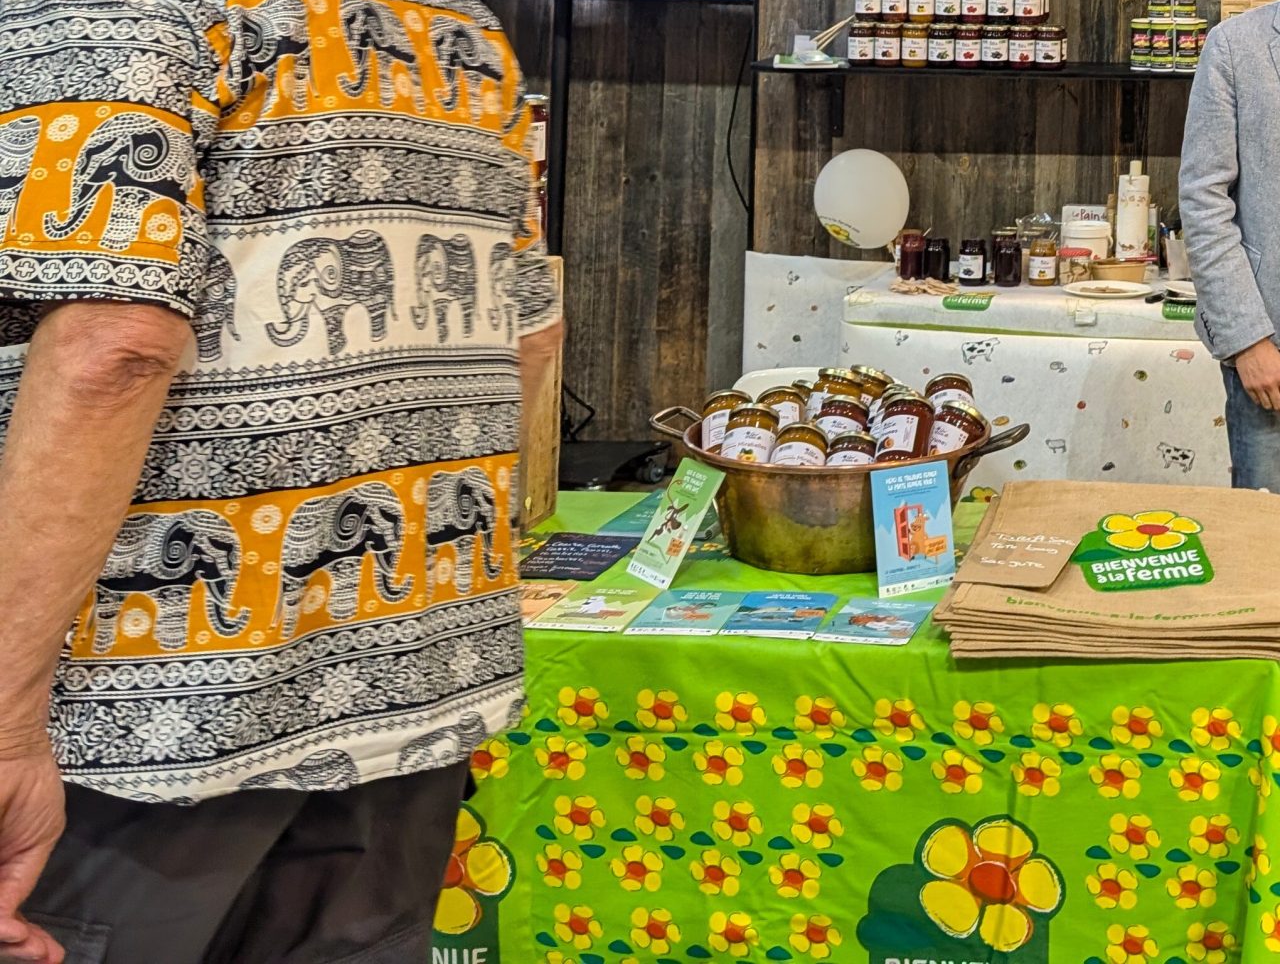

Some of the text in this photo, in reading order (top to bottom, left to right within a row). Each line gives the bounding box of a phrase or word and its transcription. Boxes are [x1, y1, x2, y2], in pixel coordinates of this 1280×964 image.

[1080, 208, 1100, 221] Pain
[1091, 549, 1200, 575] BIENVENUE
[1107, 571, 1124, 582] la
[1126, 562, 1203, 583] ferme
